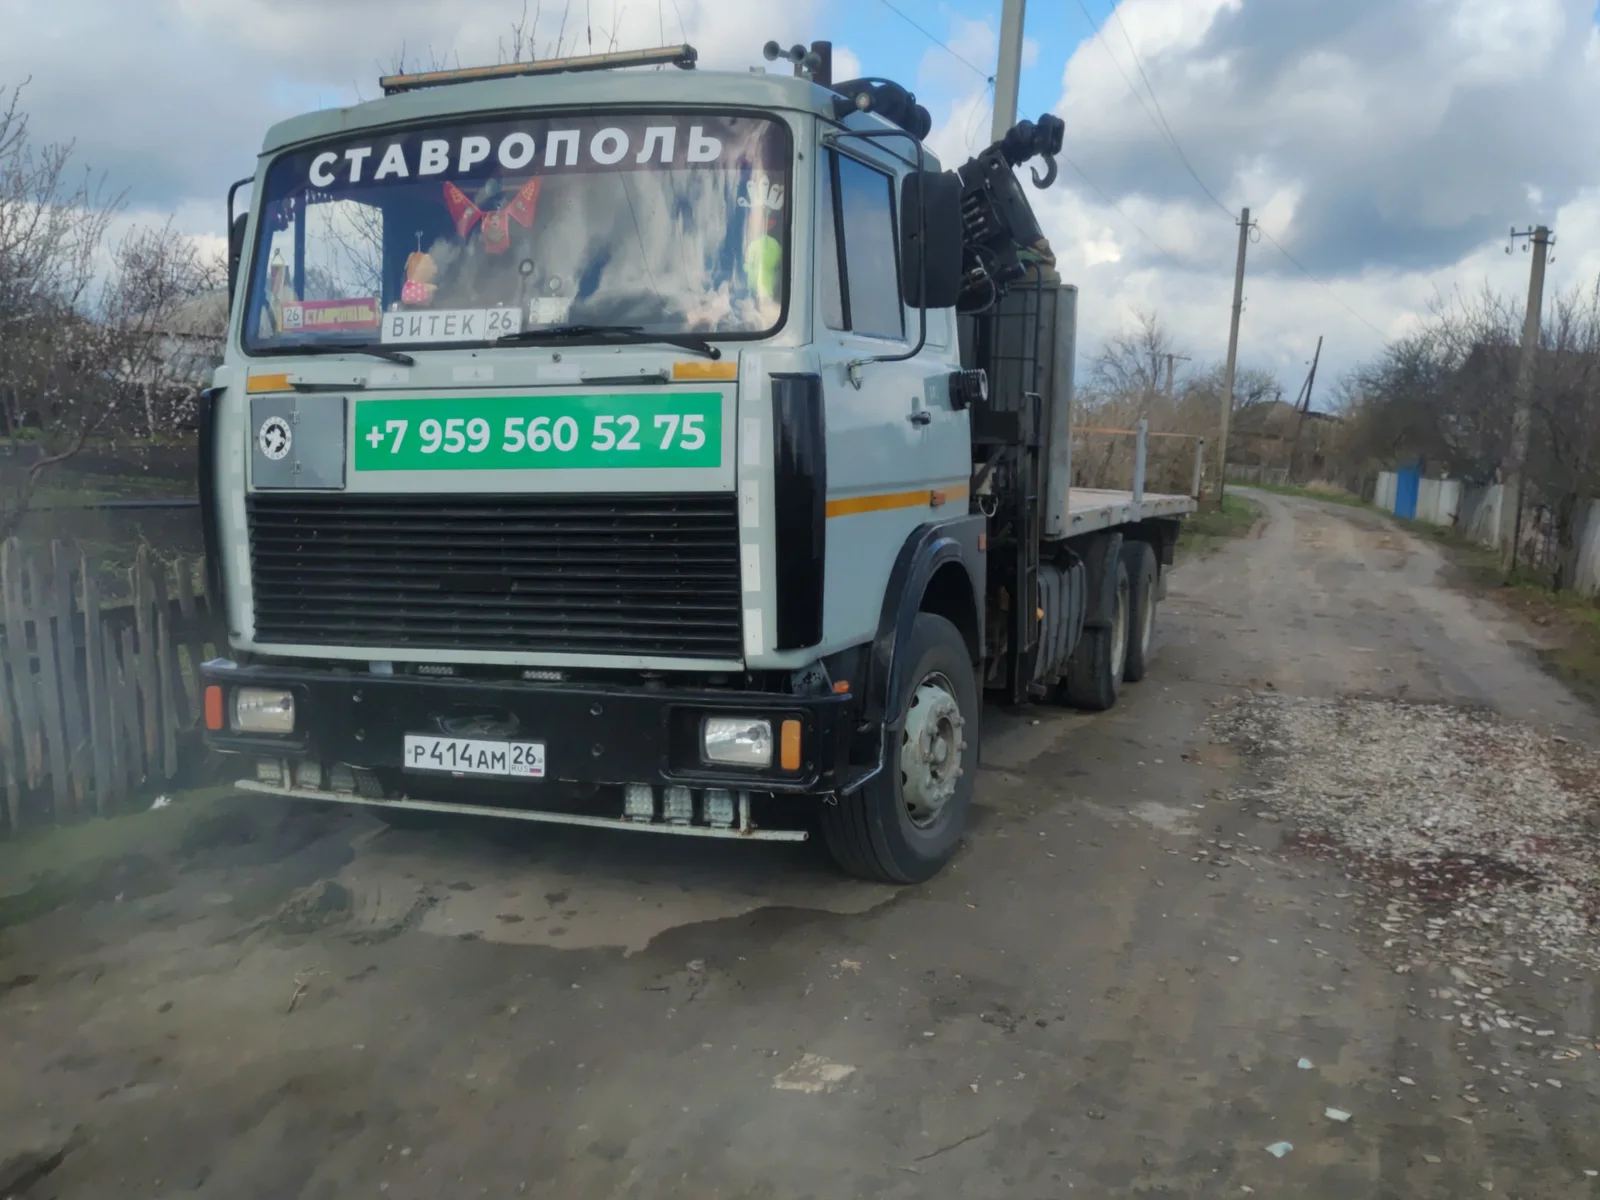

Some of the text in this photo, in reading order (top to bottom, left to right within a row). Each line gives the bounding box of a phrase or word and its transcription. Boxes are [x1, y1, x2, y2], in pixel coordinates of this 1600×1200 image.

[309, 126, 722, 187] СТАВРОПОЛЬ
[286, 308, 300, 322] 26
[489, 311, 512, 330] 26
[365, 414, 706, 454] +7 959 560 52 75
[512, 746, 537, 765] 26
[511, 764, 529, 773] RUS
